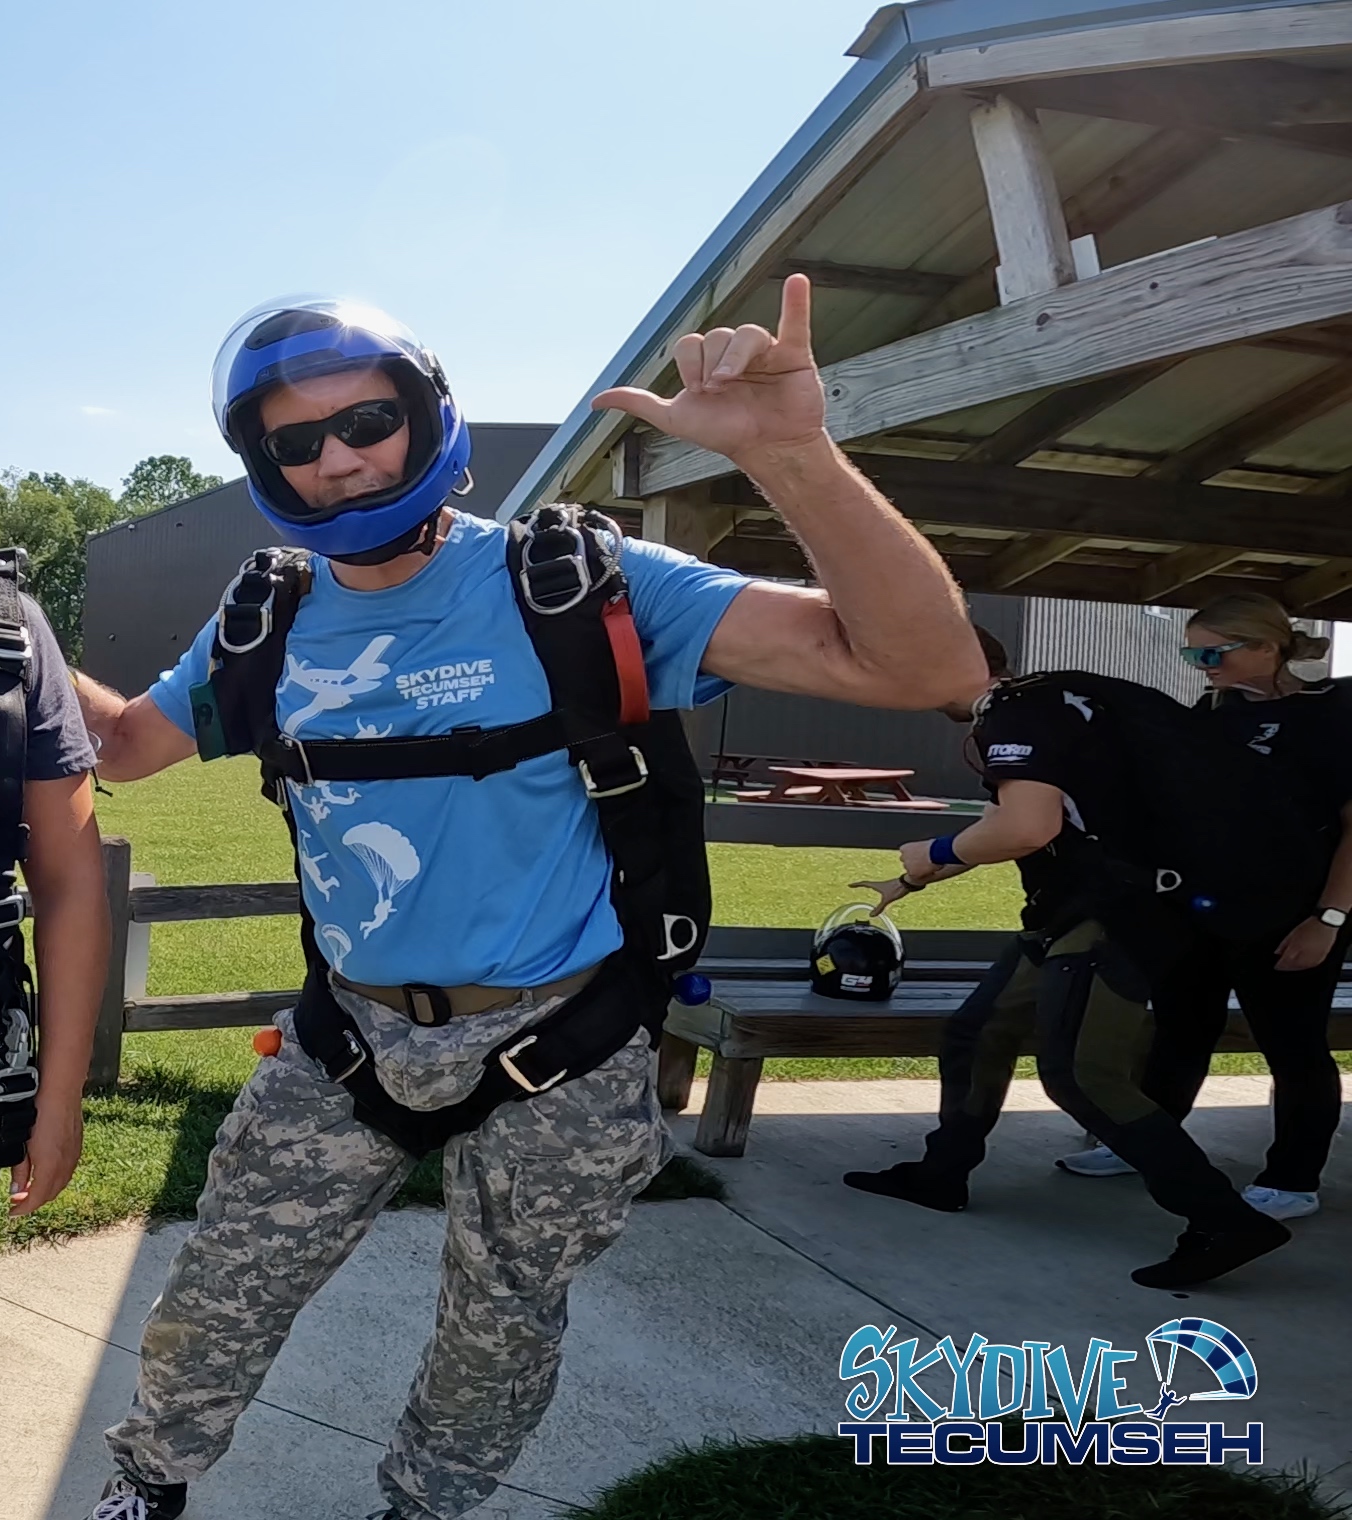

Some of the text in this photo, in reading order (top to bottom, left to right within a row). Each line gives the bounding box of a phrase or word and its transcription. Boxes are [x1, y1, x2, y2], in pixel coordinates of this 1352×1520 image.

[395, 659, 493, 689] SKYDIVE
[400, 673, 495, 700] TECUMSEH
[415, 687, 484, 710] STAFF
